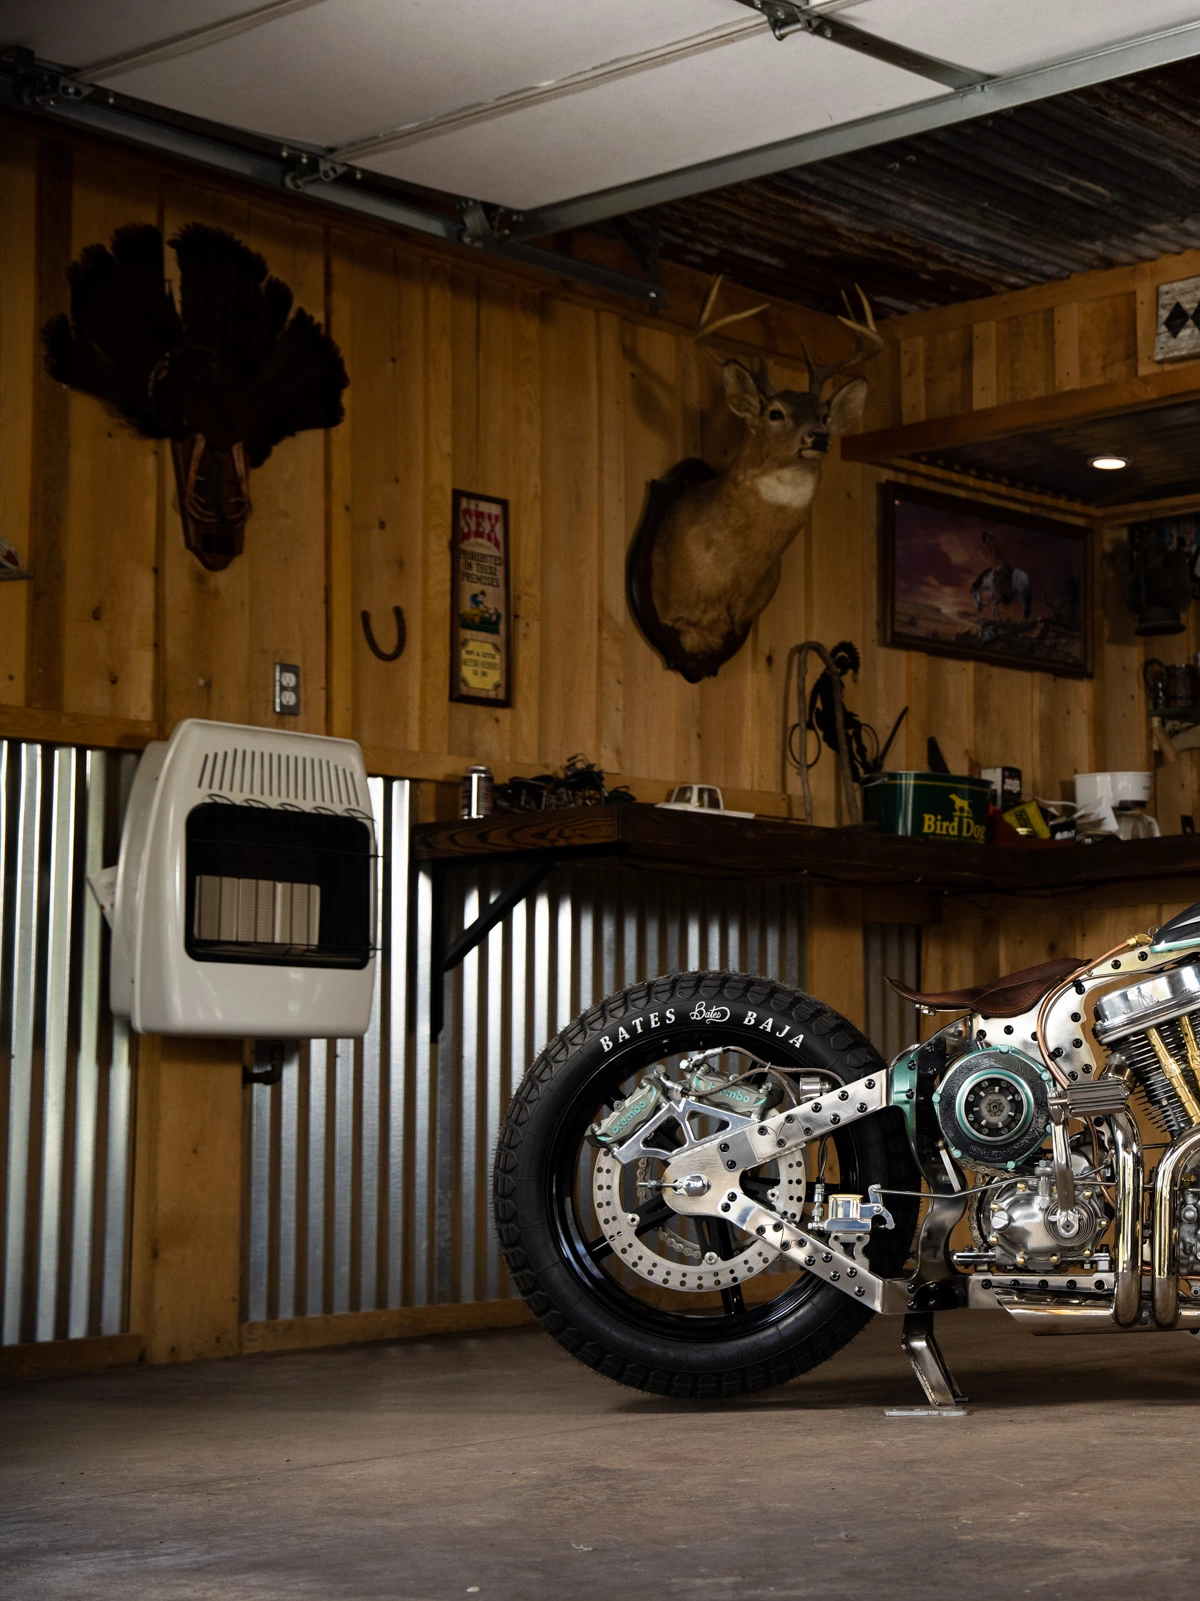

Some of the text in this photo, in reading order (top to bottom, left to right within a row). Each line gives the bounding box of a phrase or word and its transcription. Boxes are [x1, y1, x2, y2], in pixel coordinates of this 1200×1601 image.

[460, 508, 500, 552] SEX
[921, 813, 959, 836] Bird
[961, 817, 987, 844] Dog
[599, 1001, 806, 1053] BATES Bates BAJA
[609, 1100, 647, 1135] brembo
